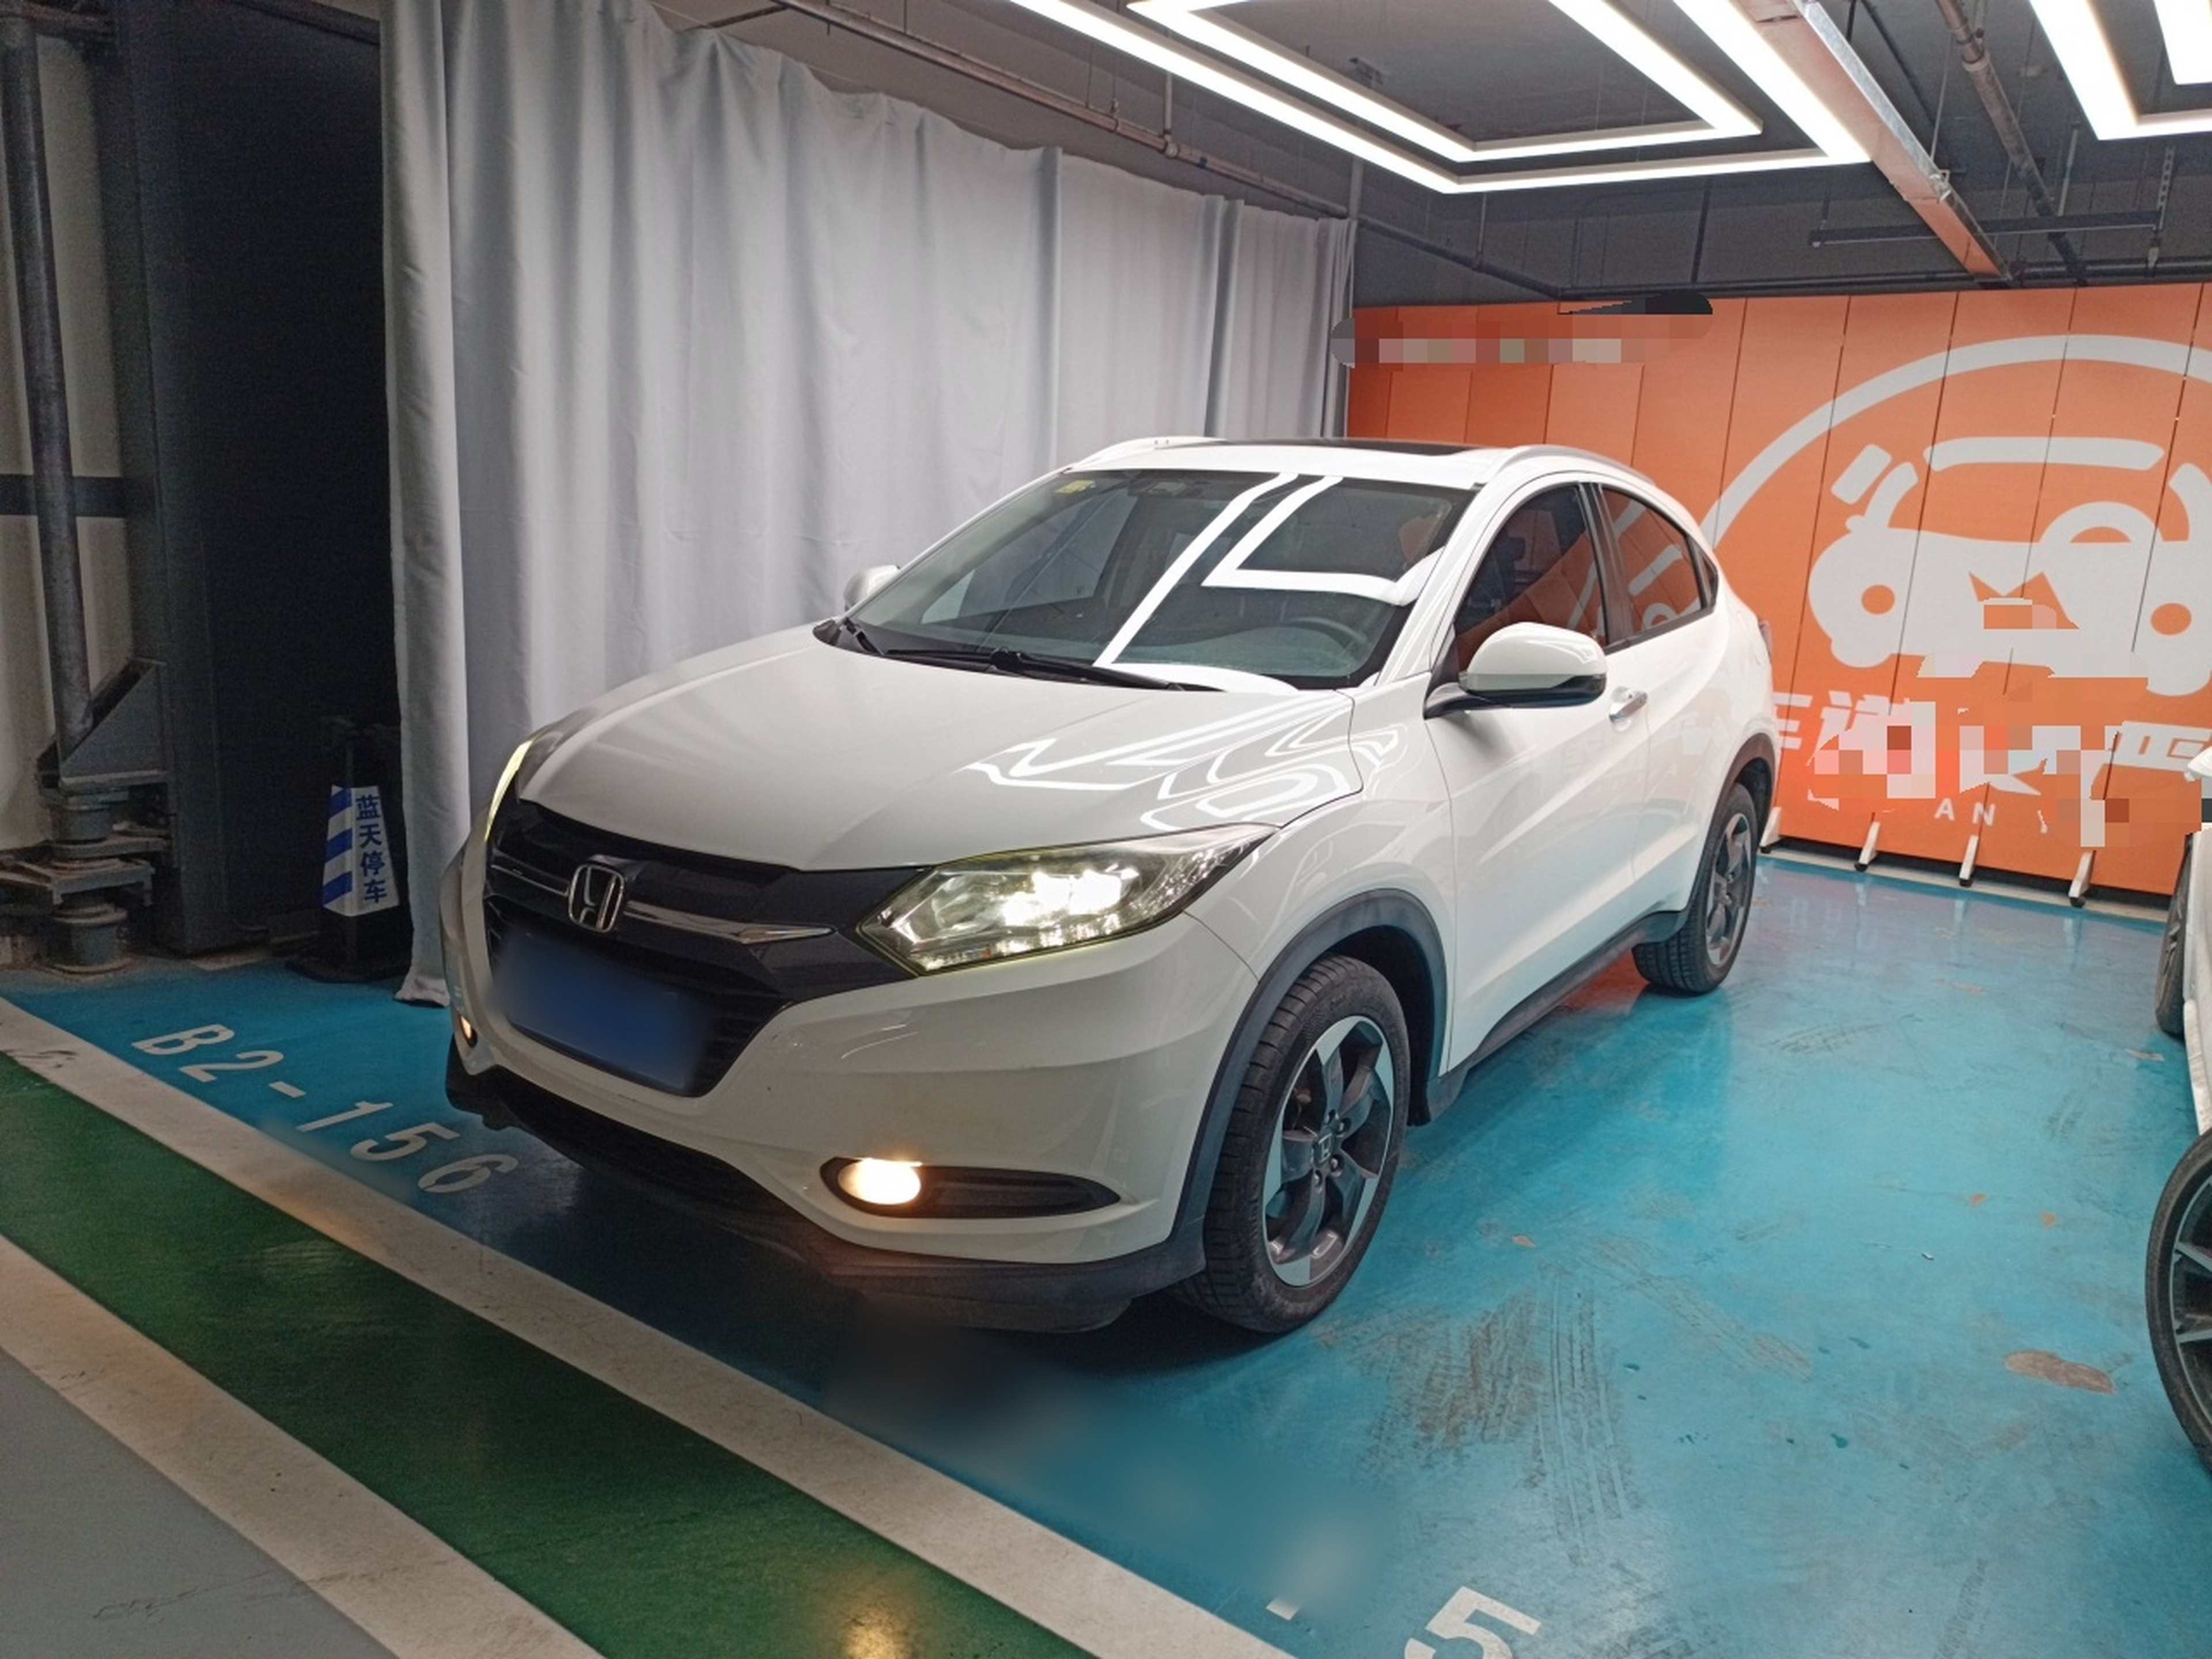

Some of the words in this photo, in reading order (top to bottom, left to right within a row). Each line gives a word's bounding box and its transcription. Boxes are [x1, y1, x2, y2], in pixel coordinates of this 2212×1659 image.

[355, 794, 388, 904] 蓝天停车
[131, 1024, 518, 1193] B2-156
